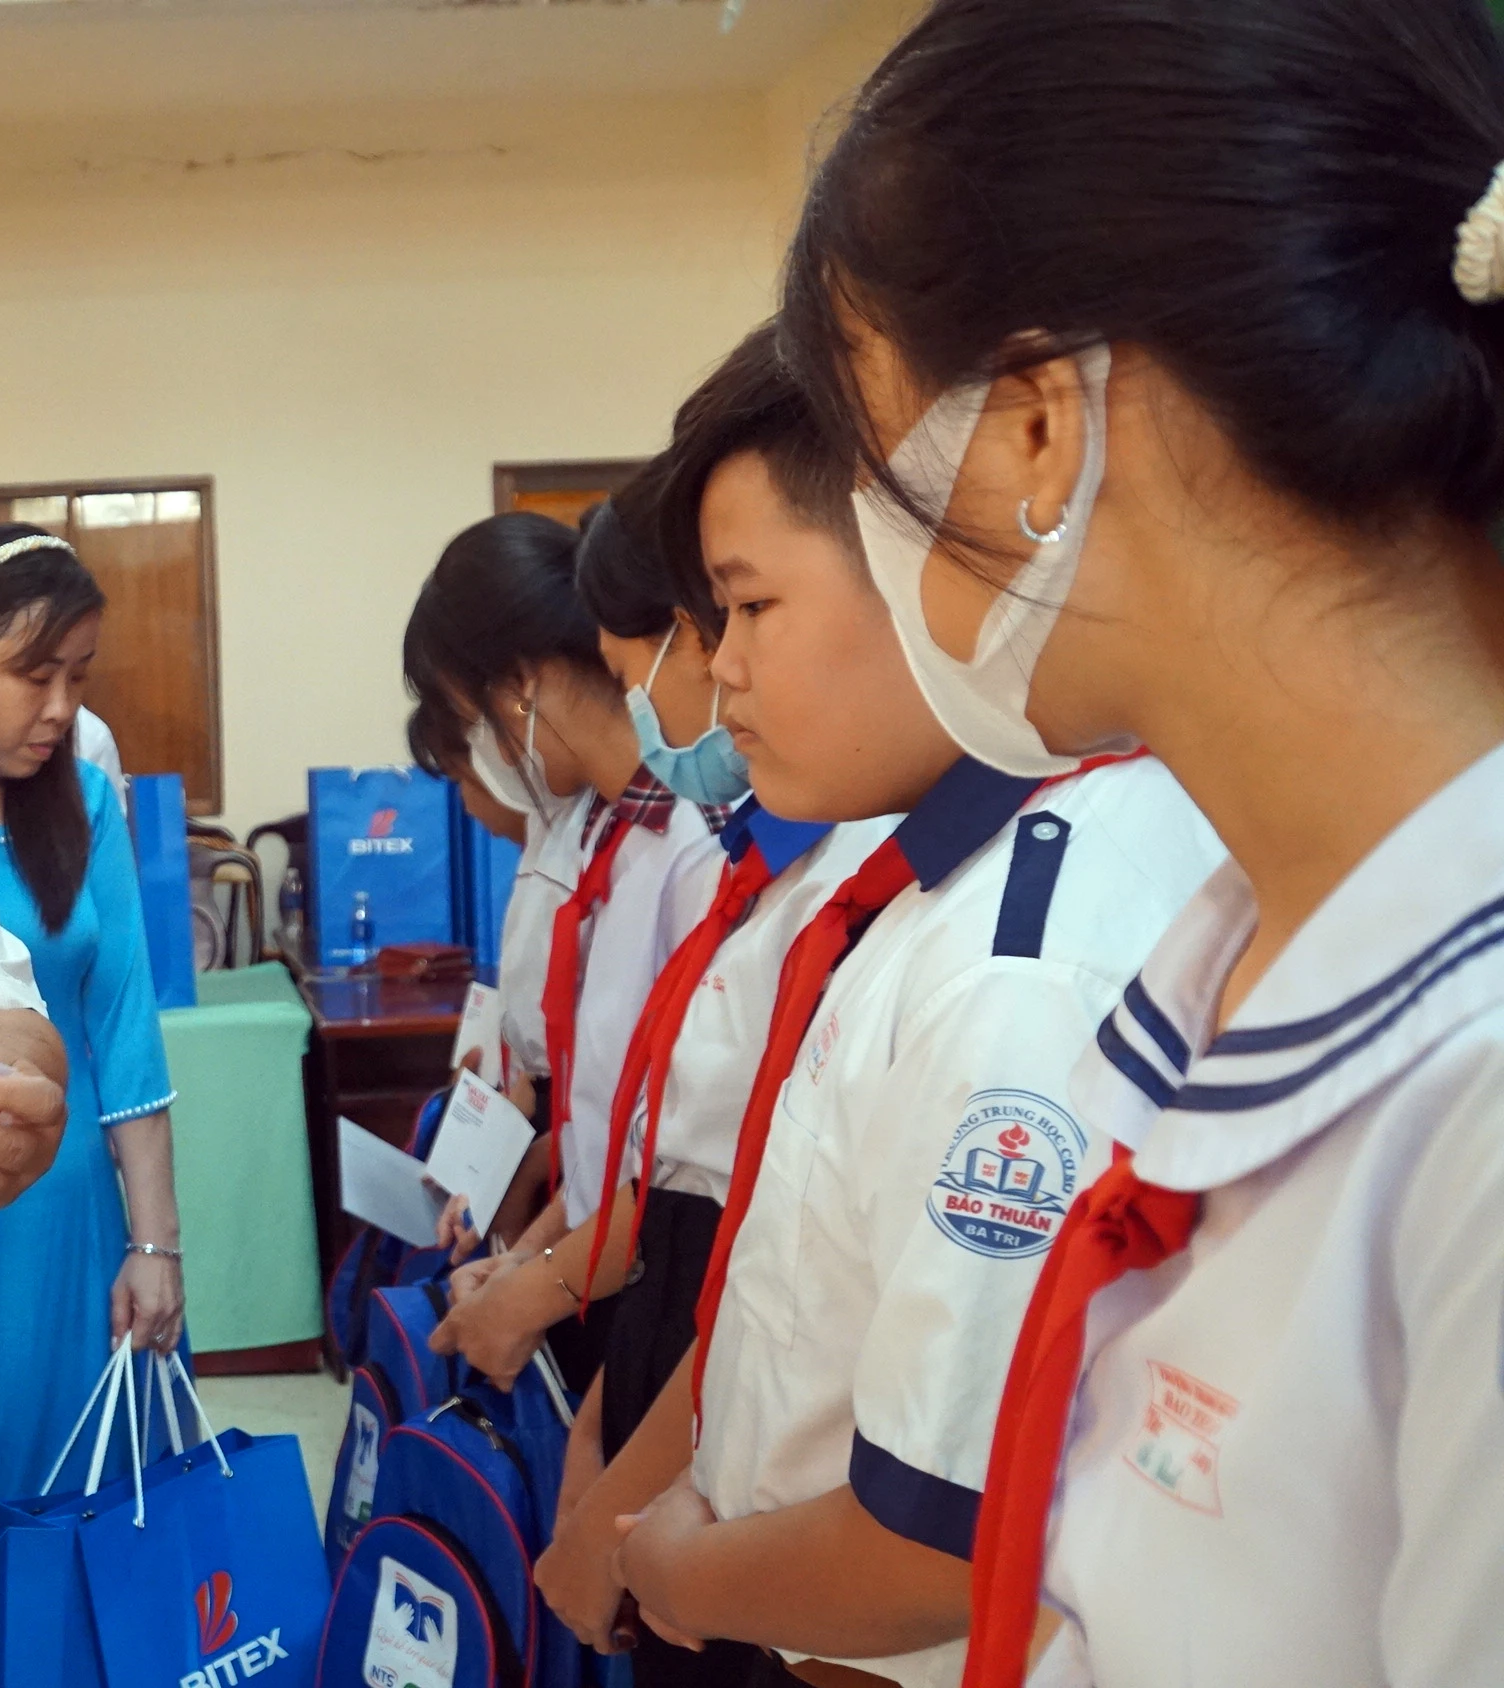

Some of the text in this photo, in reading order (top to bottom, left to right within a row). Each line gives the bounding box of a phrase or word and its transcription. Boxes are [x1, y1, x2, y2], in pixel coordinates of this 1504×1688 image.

[349, 838, 414, 855] BITEX
[980, 1105, 1036, 1121] TRUNG
[946, 1193, 983, 1214] BẢO
[964, 1223, 1021, 1247] BA TRI
[371, 1664, 395, 1688] NTS
